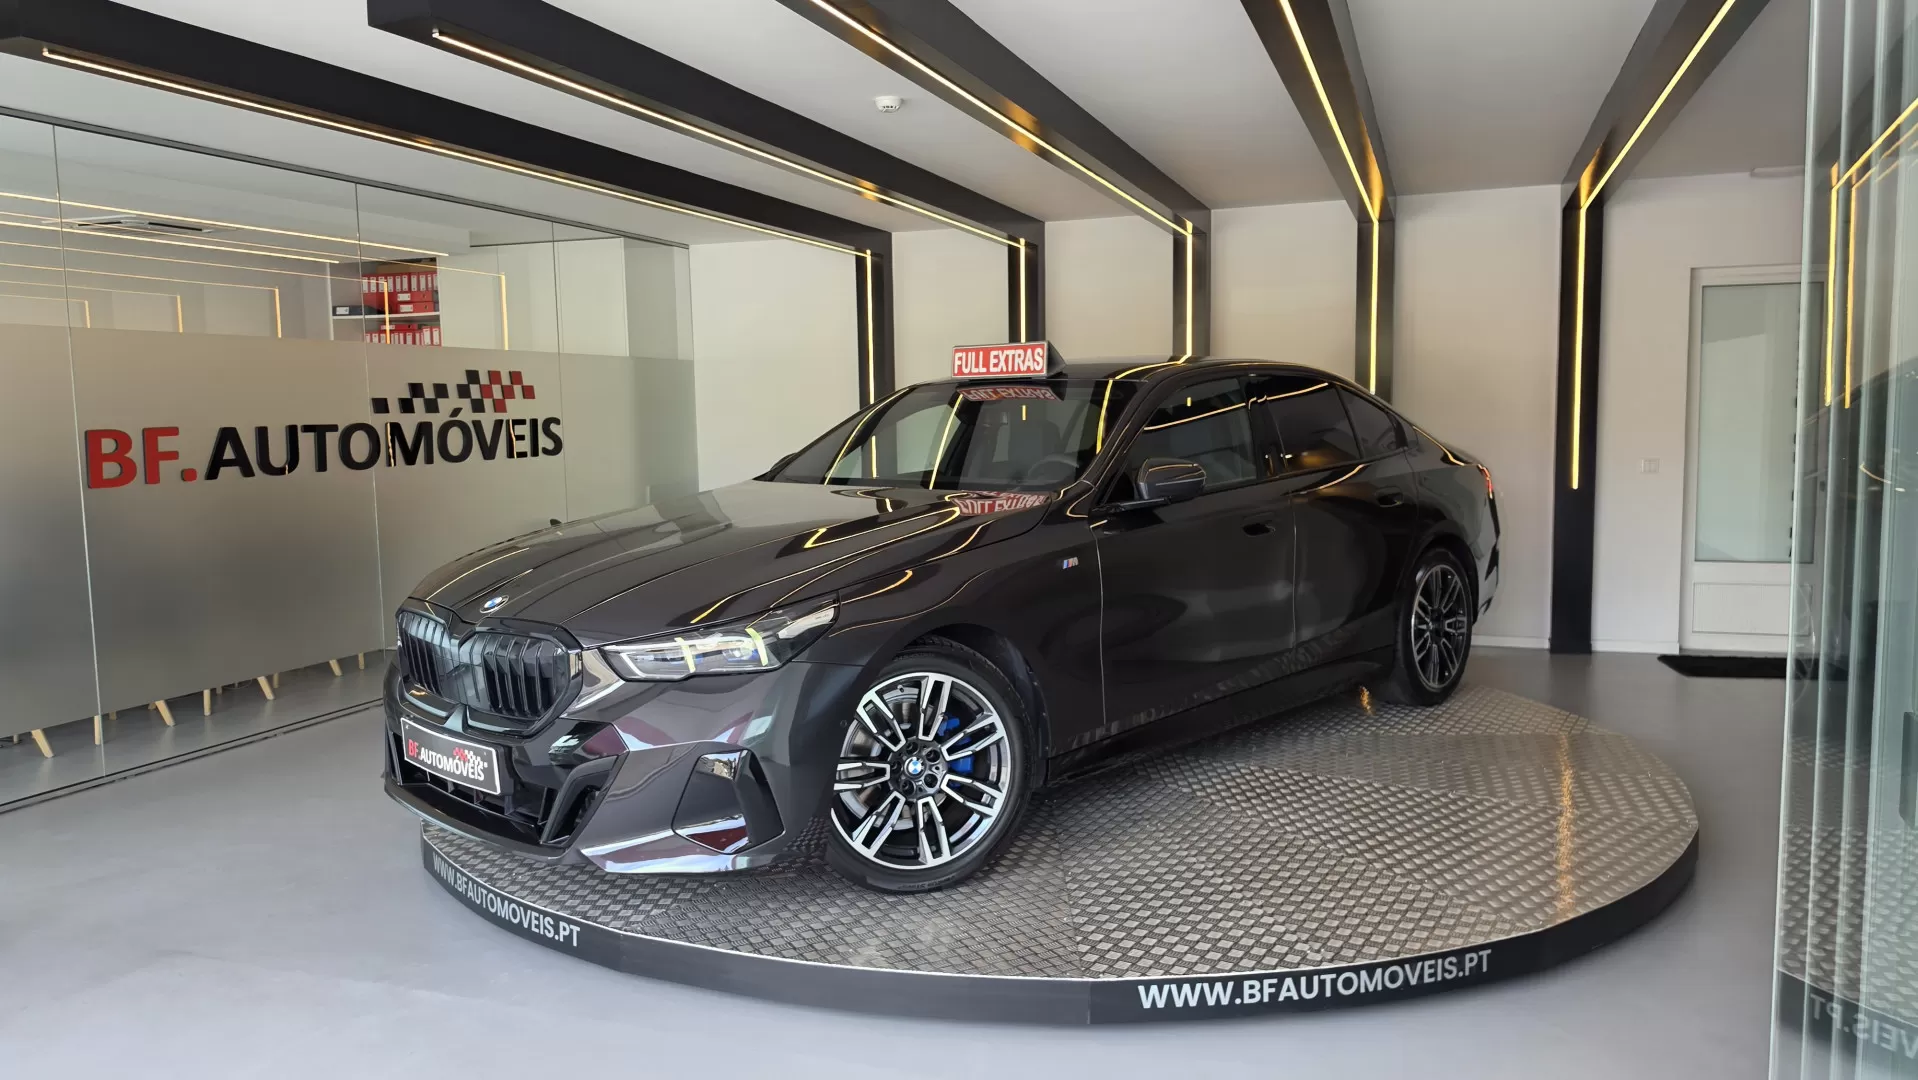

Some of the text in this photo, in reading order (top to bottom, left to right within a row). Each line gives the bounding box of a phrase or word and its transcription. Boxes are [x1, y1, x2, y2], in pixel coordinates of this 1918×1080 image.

[954, 347, 1043, 374] FULL EXTRAS
[432, 852, 581, 947] WWW.BFAUTOMOVEIS.PT
[1138, 949, 1492, 1009] WWW.BFAUTOMOVEIS.PT
